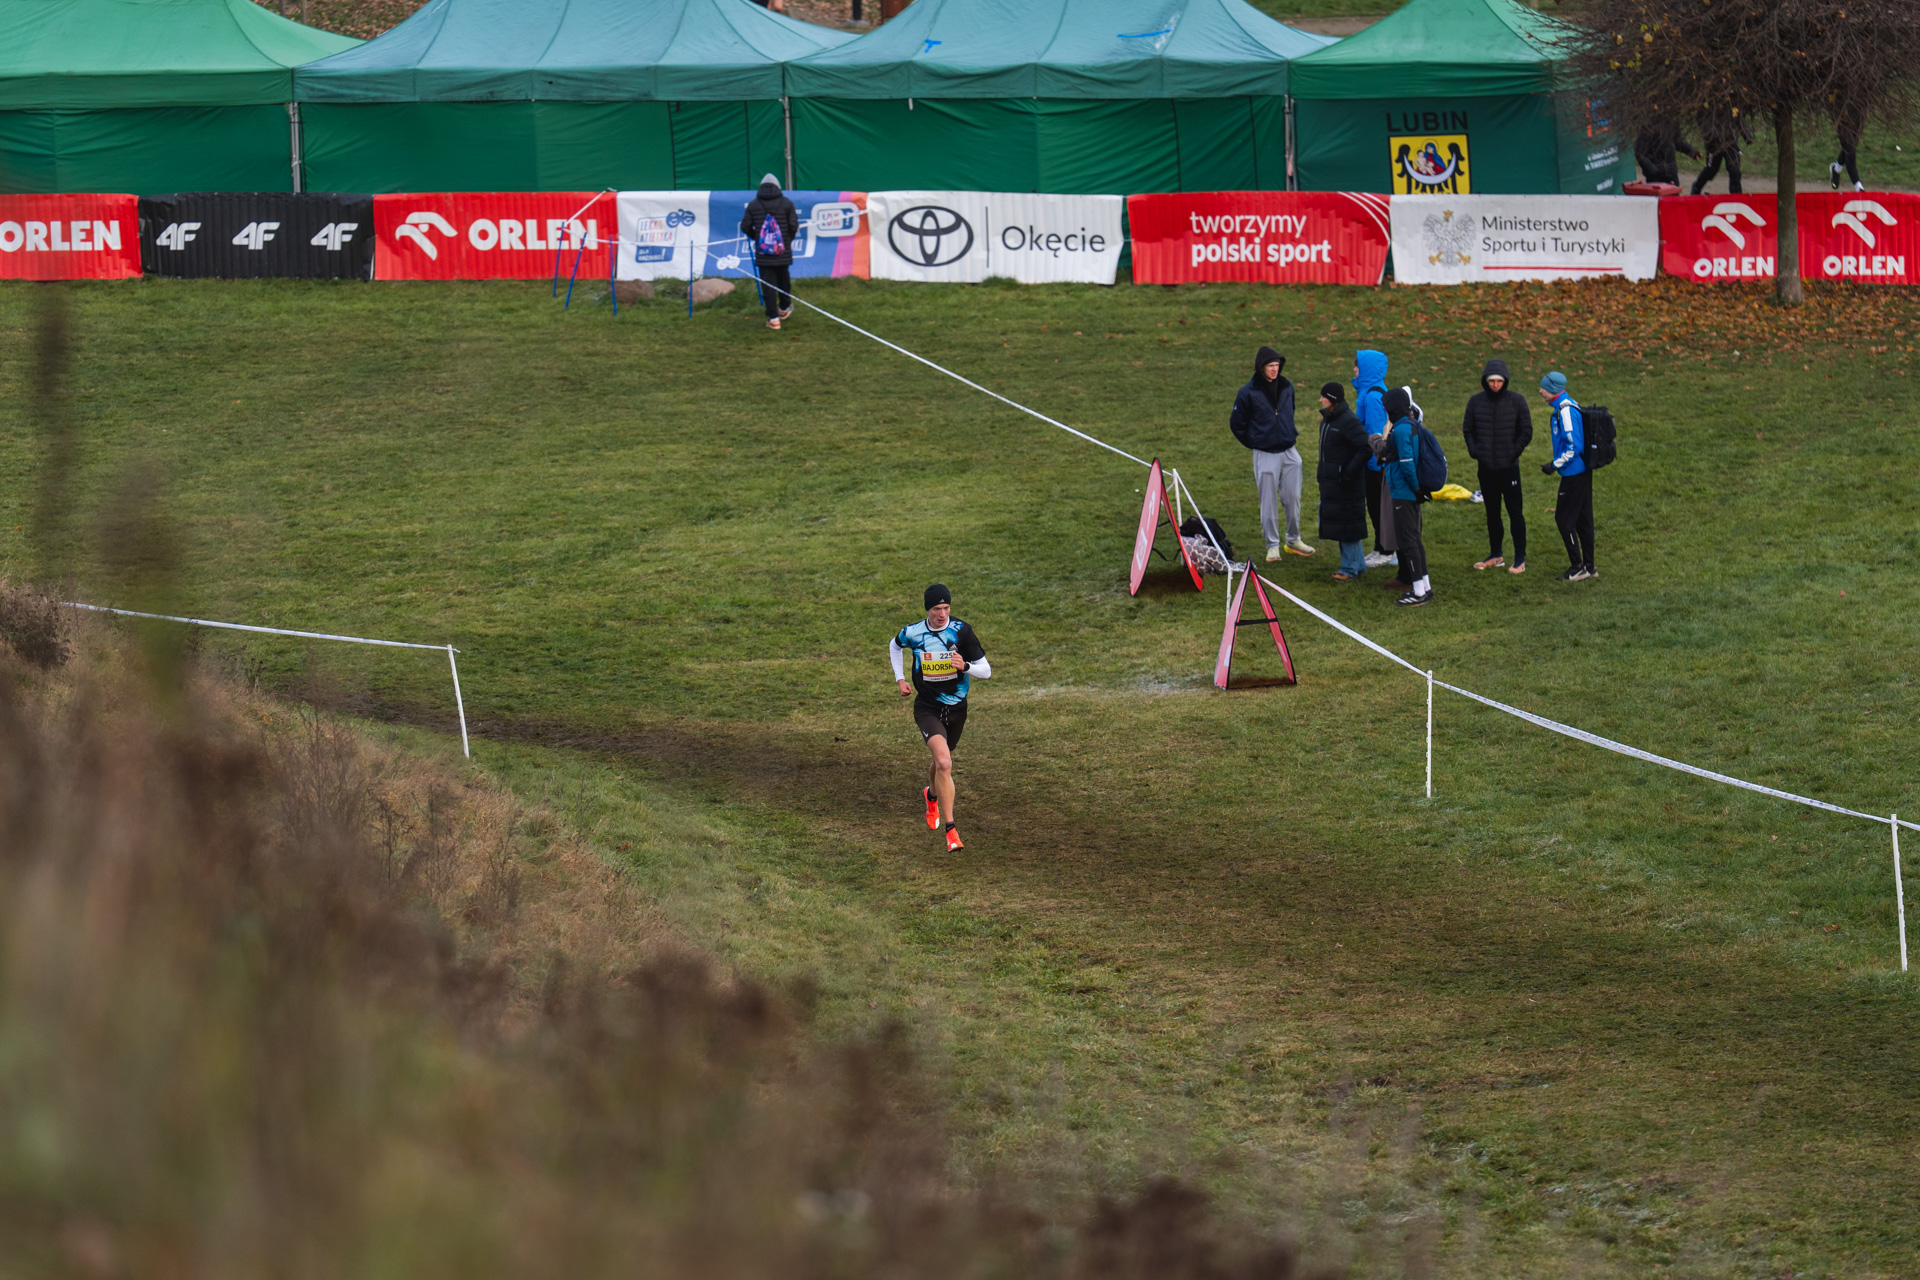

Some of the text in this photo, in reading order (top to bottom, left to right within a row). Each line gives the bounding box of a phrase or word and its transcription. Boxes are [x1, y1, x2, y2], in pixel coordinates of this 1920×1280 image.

[1386, 110, 1469, 132] LUBIN
[0, 220, 122, 252] ORLEN
[156, 222, 202, 250] 4F
[232, 222, 280, 250] 4F
[310, 222, 358, 250] 4F
[468, 218, 598, 251] ORLEN
[1189, 211, 1307, 238] tworzymy
[1482, 216, 1589, 231] Ministerstwo
[1002, 225, 1105, 258] Okęcie
[1191, 236, 1332, 267] polski sport
[1482, 237, 1625, 256] Sportu i Turystyki
[1693, 256, 1774, 277] ORLEN
[1823, 255, 1905, 276] ORLEN
[922, 663, 955, 671] BAJORSK
